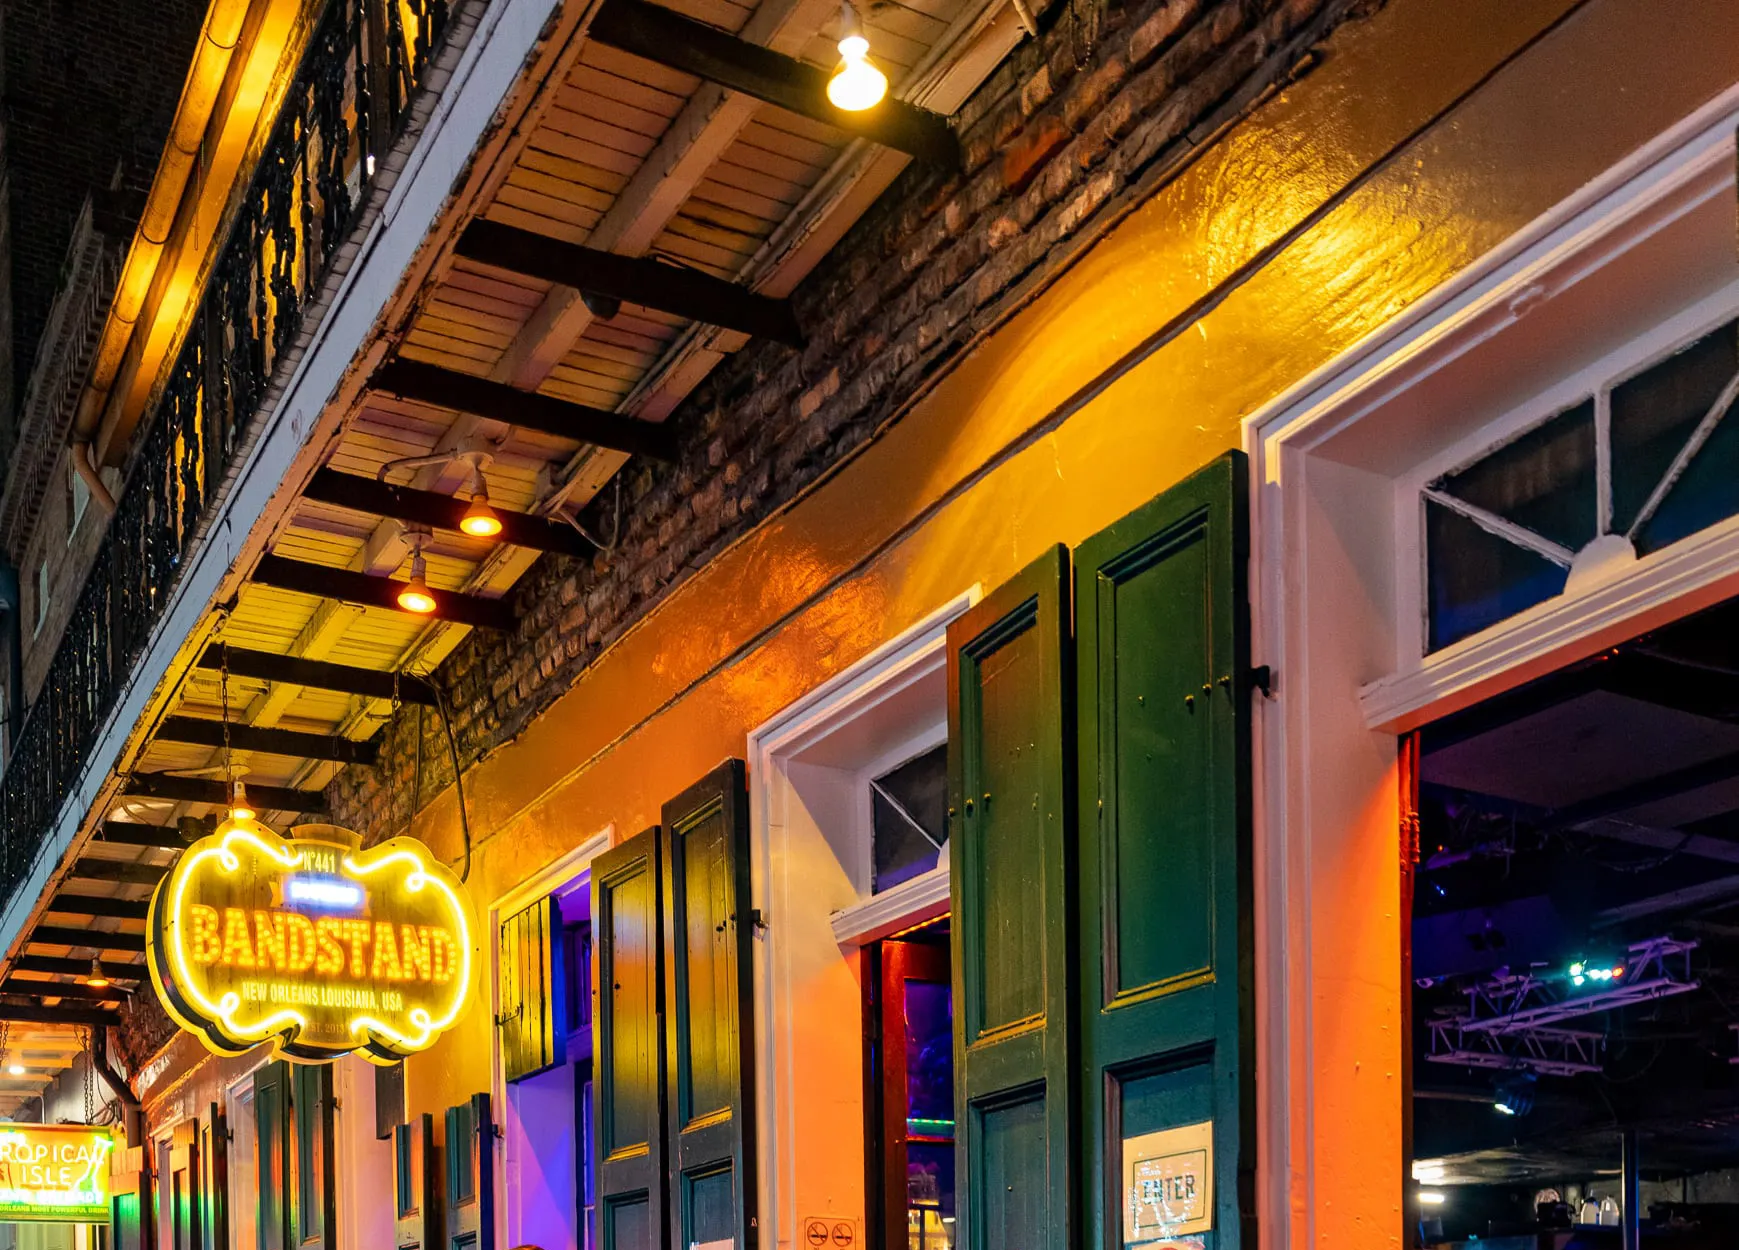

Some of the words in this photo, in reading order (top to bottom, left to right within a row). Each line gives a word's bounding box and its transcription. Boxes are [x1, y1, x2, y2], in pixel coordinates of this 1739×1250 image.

[191, 904, 457, 983] BANDSTAND
[242, 982, 267, 1001] NEW
[270, 984, 319, 1006] ORLEANS
[321, 987, 379, 1013] LOUISIANA,
[382, 992, 403, 1012] USA
[0, 1144, 104, 1164] ROPICAL
[22, 1165, 71, 1186] ISLE
[1143, 1174, 1195, 1205] ENTER
